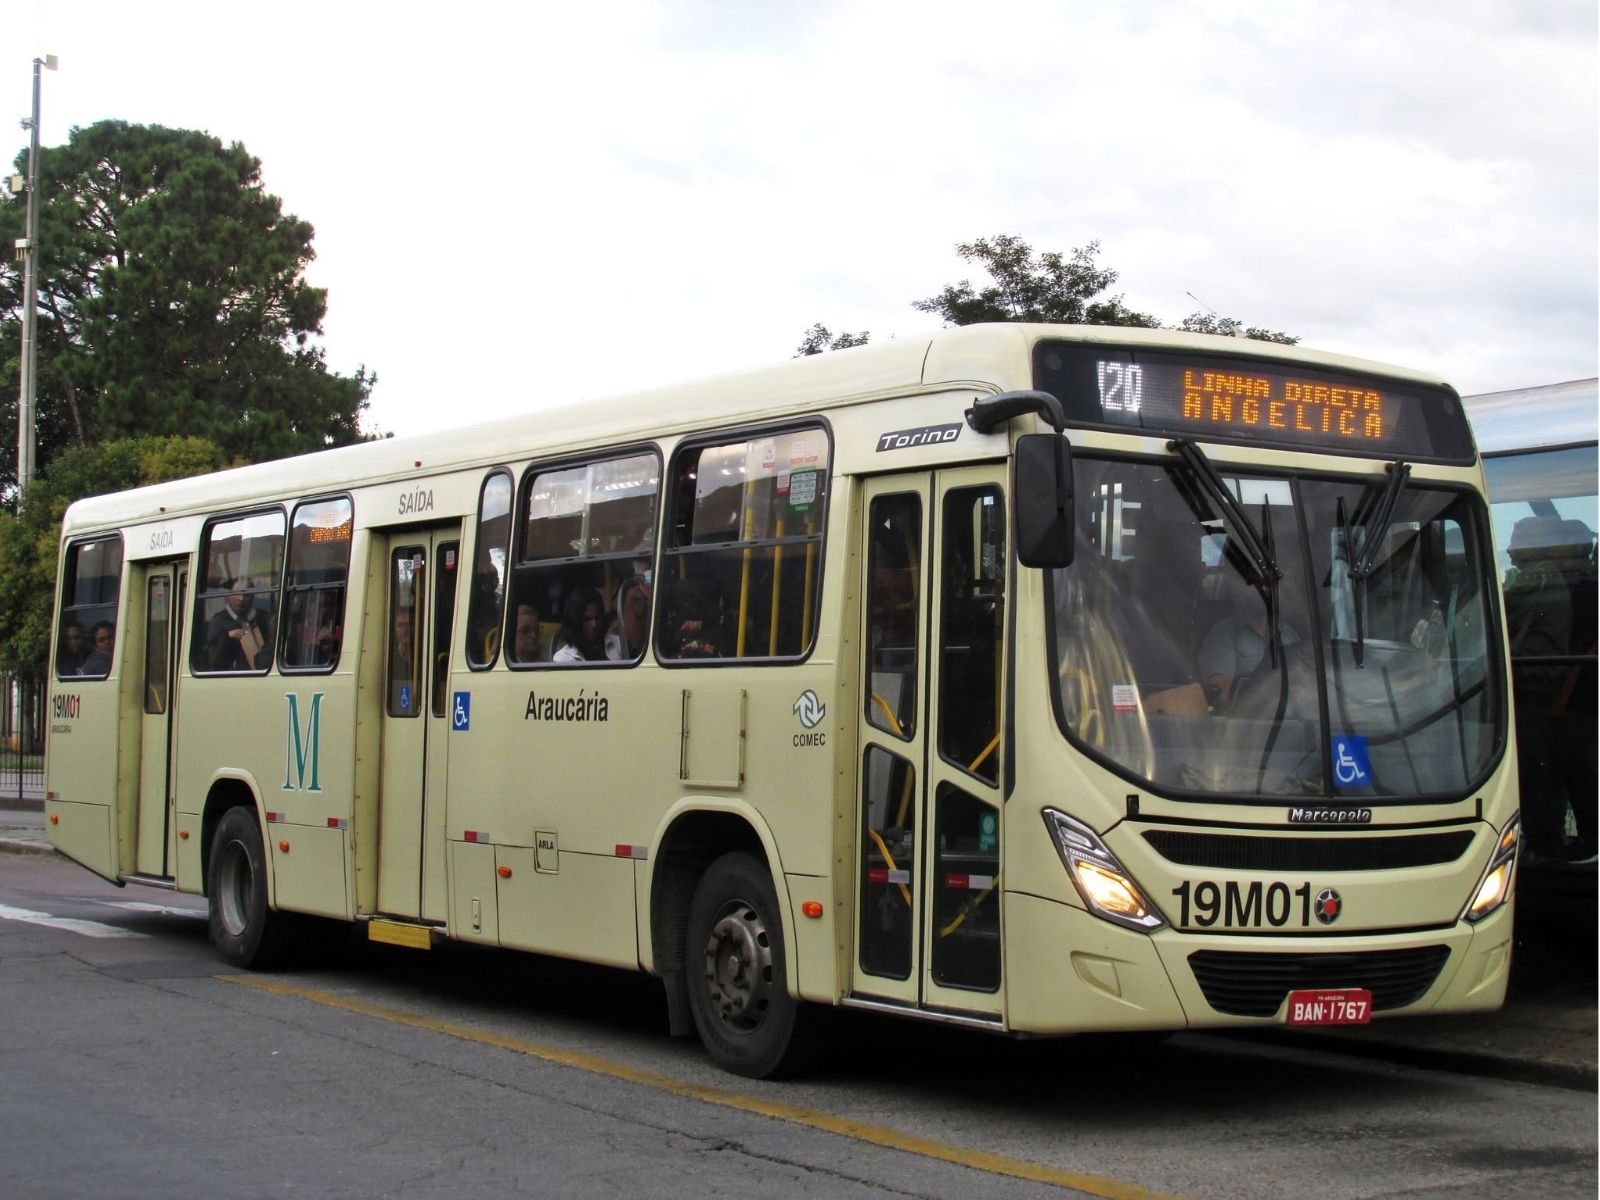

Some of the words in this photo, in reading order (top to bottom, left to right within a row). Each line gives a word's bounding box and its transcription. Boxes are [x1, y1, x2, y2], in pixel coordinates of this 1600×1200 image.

[1184, 370, 1269, 398] LINHA
[1285, 382, 1379, 410] DIRETA
[1184, 392, 1381, 438] ANGELICA
[881, 429, 958, 449] Torino
[396, 485, 434, 515] SAÍDA
[150, 527, 173, 551] SAÍDA
[52, 694, 81, 719] 19M01
[525, 689, 608, 722] Araucária
[282, 693, 325, 793] M
[793, 733, 826, 747] COMEC
[1291, 808, 1371, 822] Marcopolo
[538, 839, 555, 850] ARLA
[1172, 880, 1311, 927] 19M01
